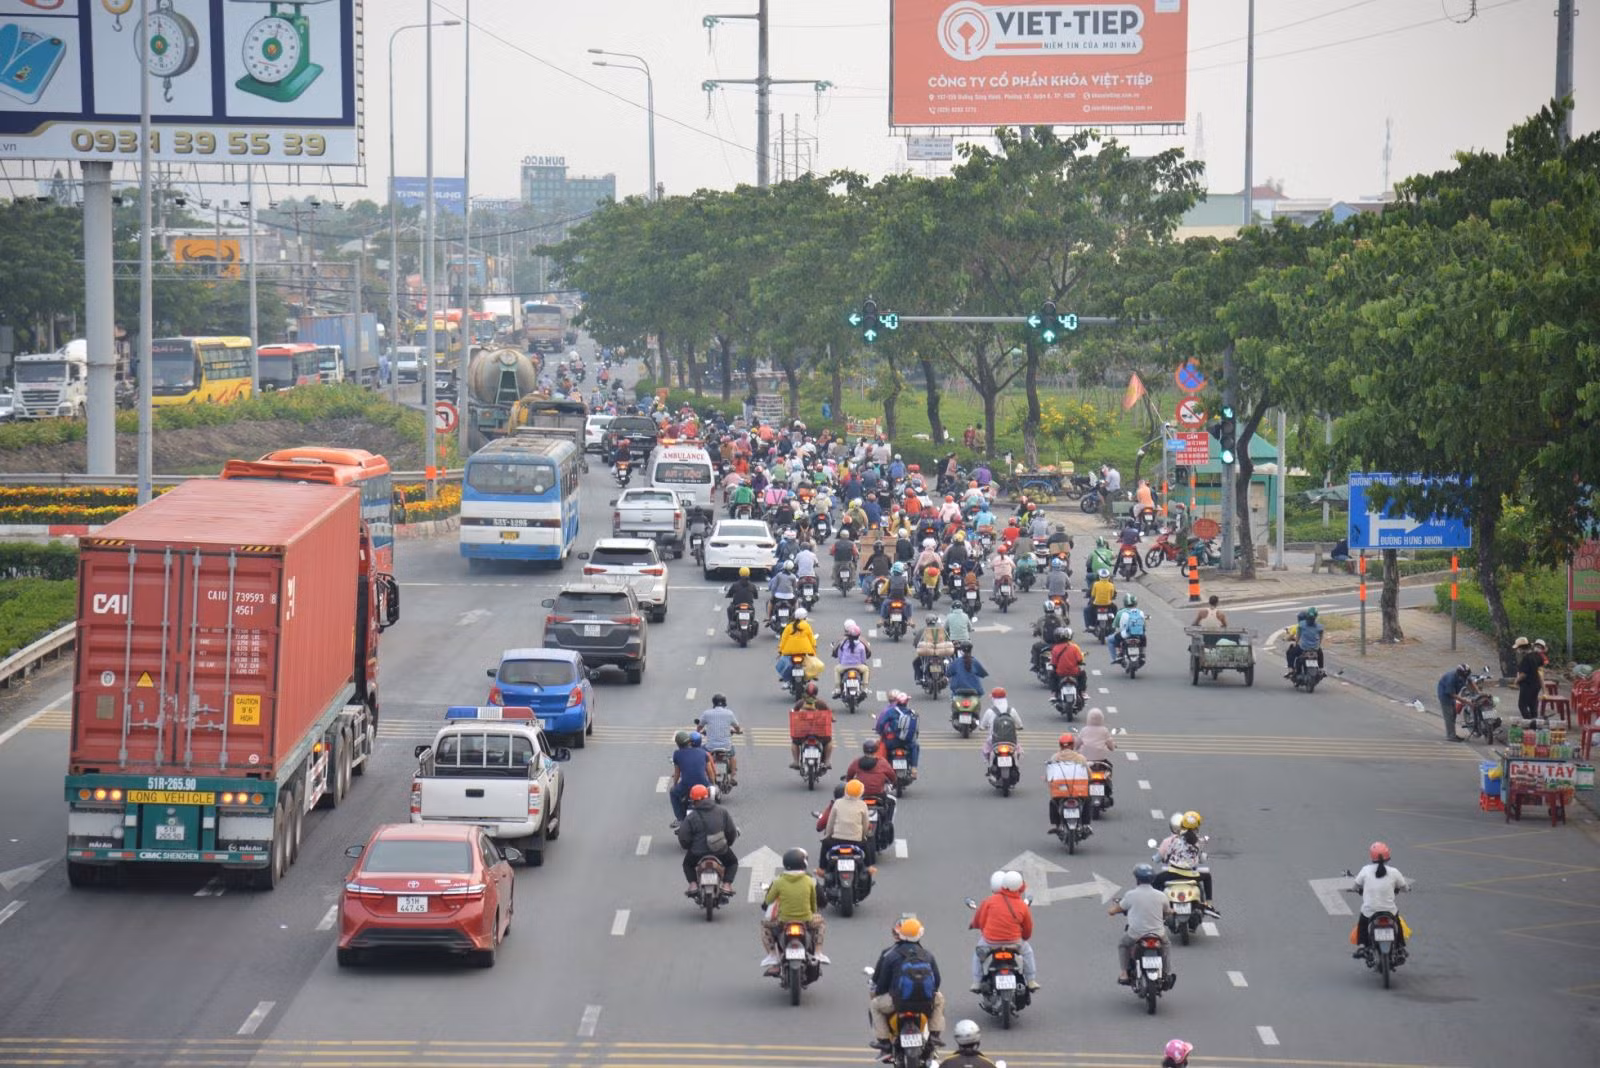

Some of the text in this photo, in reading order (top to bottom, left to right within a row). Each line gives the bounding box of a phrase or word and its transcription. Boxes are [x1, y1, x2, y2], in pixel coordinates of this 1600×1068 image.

[996, 10, 1139, 36] VIET-TIEP
[928, 74, 967, 87] CÔNG
[970, 76, 986, 87] TY
[1051, 72, 1088, 86] KHÓA
[174, 131, 217, 154] 39
[228, 132, 271, 155] 55
[283, 133, 326, 156] 39
[879, 313, 898, 330] 40
[1058, 313, 1078, 330] 40
[663, 452, 705, 460] AMBULANCE
[93, 594, 129, 614] CAI
[207, 590, 277, 604] CAIU 739593 8
[235, 606, 254, 615] 45G1
[236, 697, 259, 705] CAUTION
[1546, 763, 1575, 778] TÂY
[147, 777, 197, 791] 51R-265.90
[129, 792, 213, 804] LONG VEHICLE
[162, 852, 199, 860] SHENZHEN
[400, 904, 425, 913] 447.45
